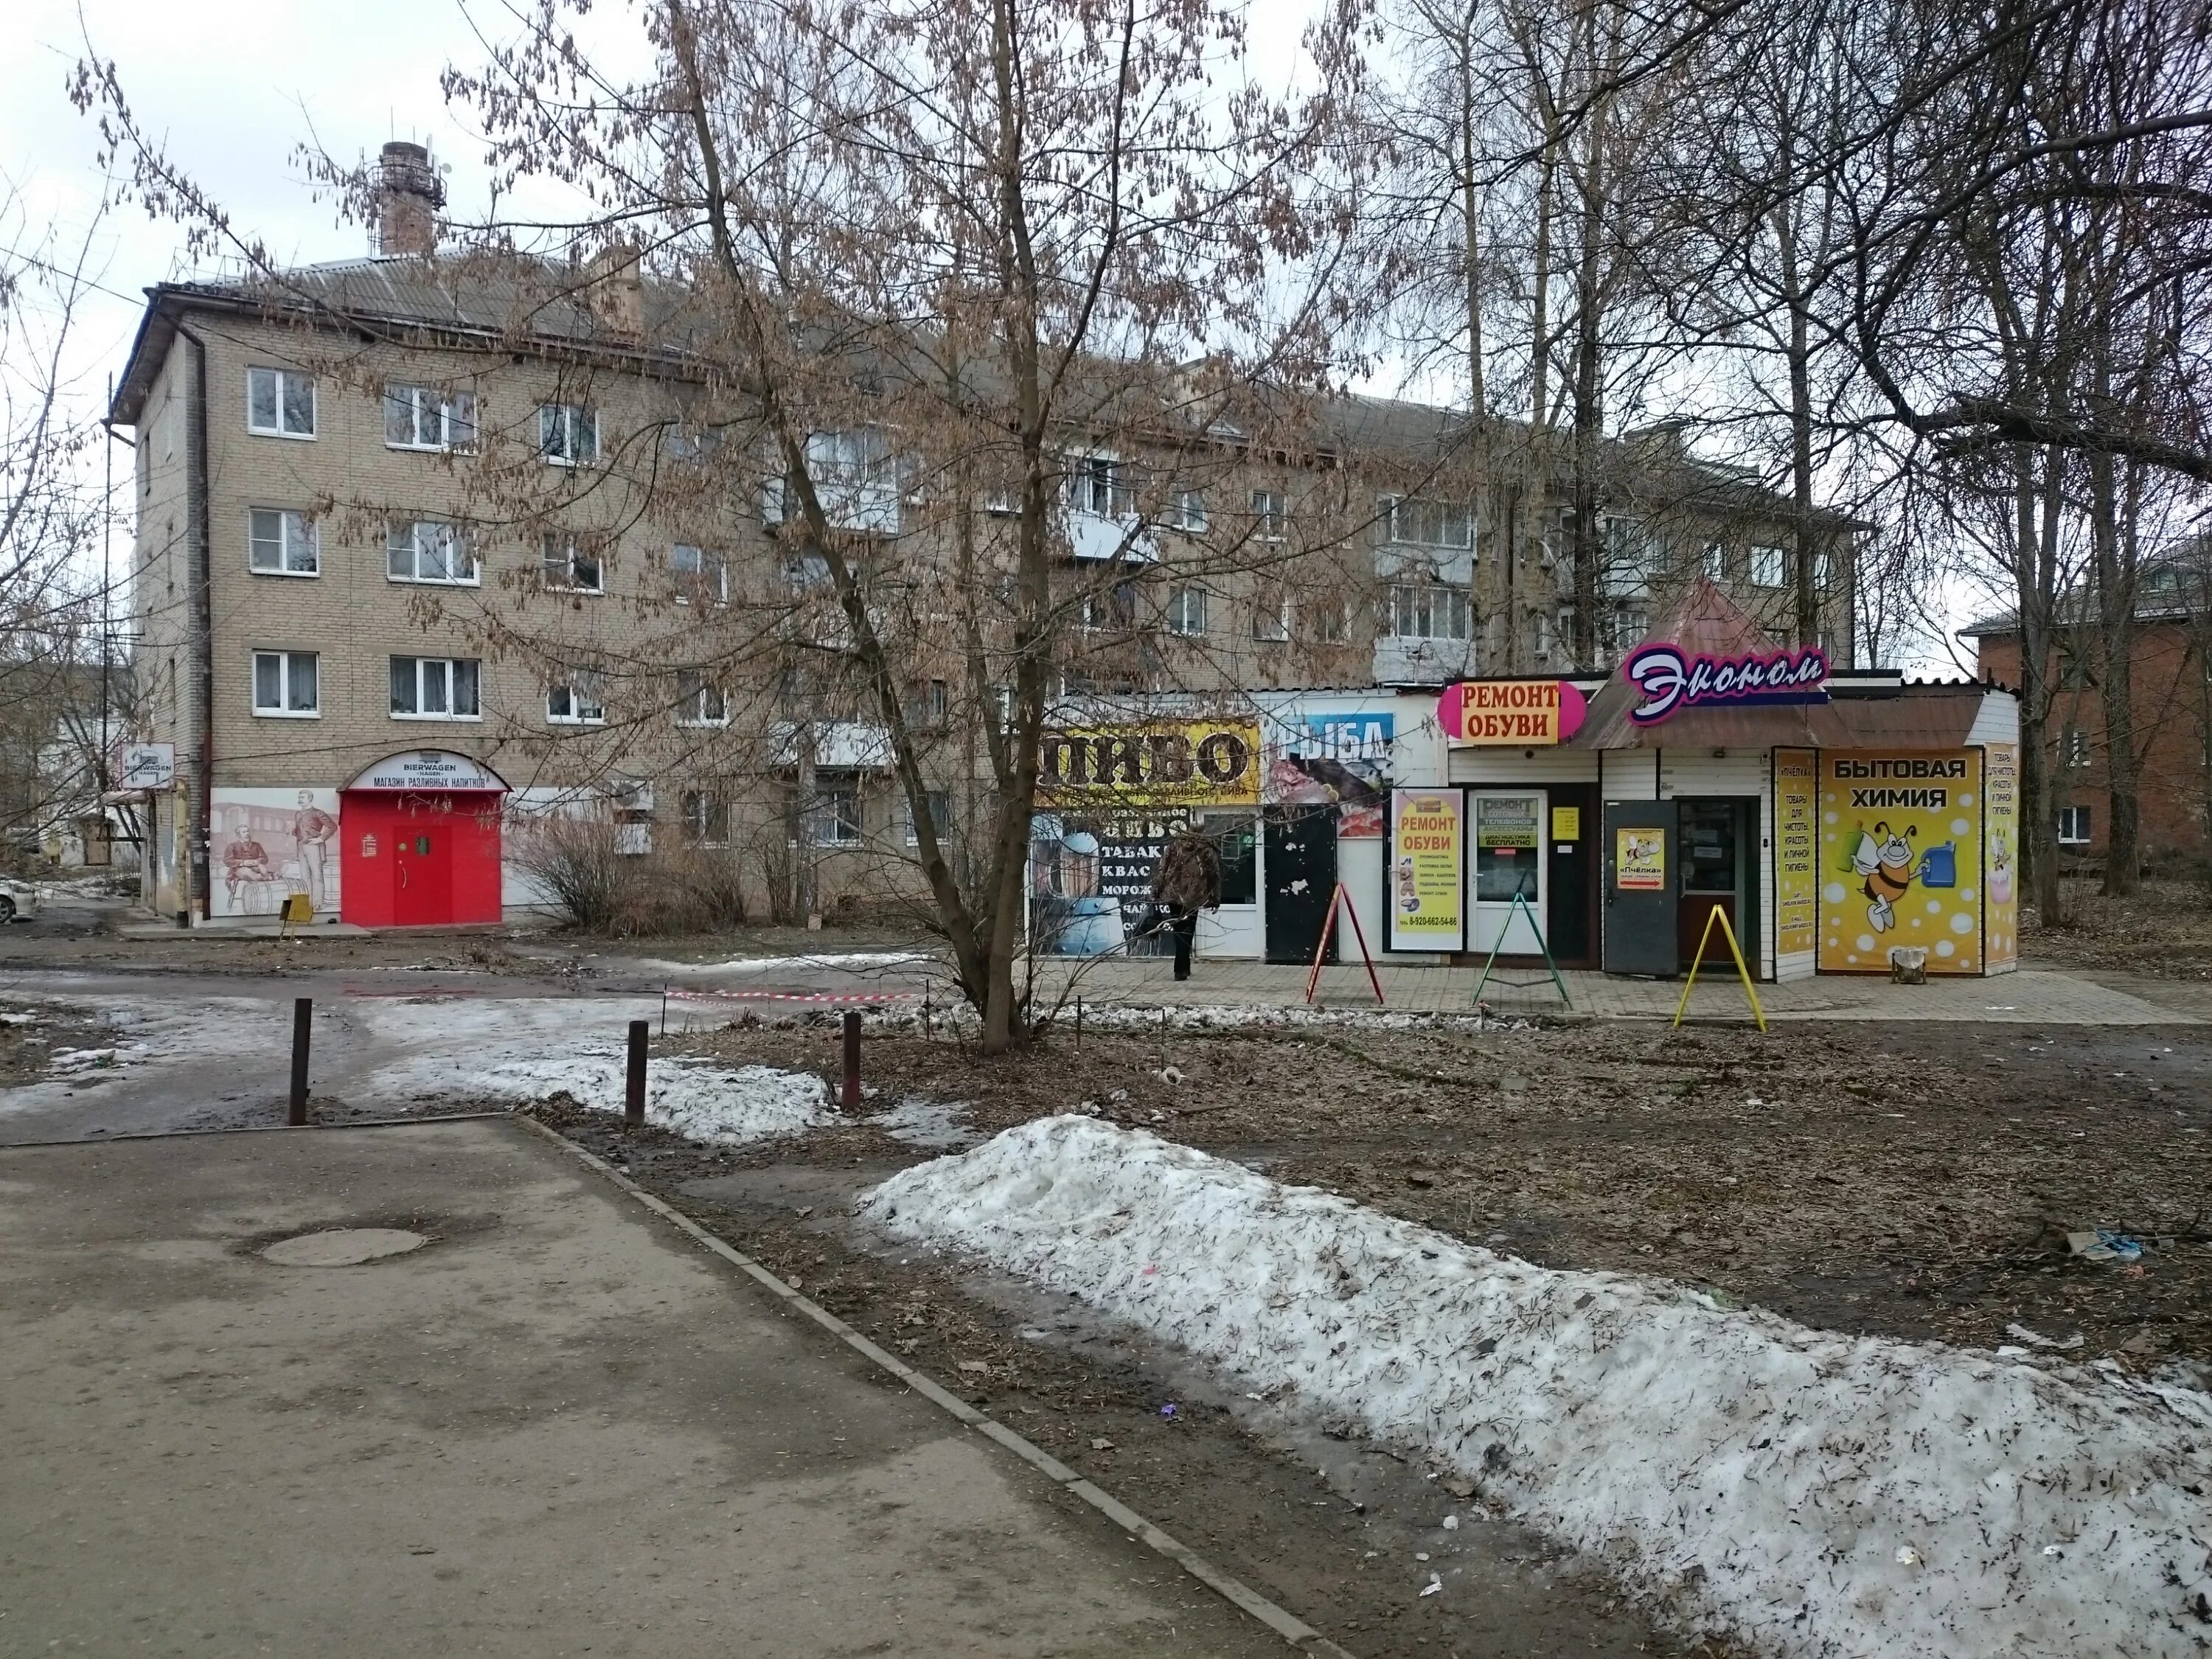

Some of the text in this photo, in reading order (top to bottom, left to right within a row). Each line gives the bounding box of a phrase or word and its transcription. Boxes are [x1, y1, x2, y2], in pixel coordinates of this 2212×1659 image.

[1632, 653, 1823, 716] Эконом
[1462, 685, 1559, 708] РЕМОНТ
[1467, 714, 1548, 737] ОБУВИ
[1276, 721, 1387, 761] РЫБА
[1036, 731, 1249, 785] ПИВО
[1834, 759, 1966, 779] БЫТОВАЯ
[374, 777, 485, 788] МАГАЗИН РАЗЛИВНЫХ НАПИТКОВ
[1786, 795, 1807, 804] ТОВАРЫ
[1851, 789, 1947, 807] ХИМИЯ
[1483, 800, 1533, 817] РЕМОНТ
[1791, 809, 1802, 818] ДЛЯ
[1402, 817, 1455, 831] РЕМОНТ
[1404, 836, 1450, 850] ОБУВИ
[1785, 836, 1808, 846] КРАСОТЫ
[1784, 847, 1809, 860] И ЛИЧНОЙ
[1102, 865, 1150, 877] КВАС
[1785, 863, 1809, 873] ГИГИЕНЫ
[1102, 885, 1152, 895] МОРОЖ
[1409, 917, 1457, 926] 8-920-662-54-86
